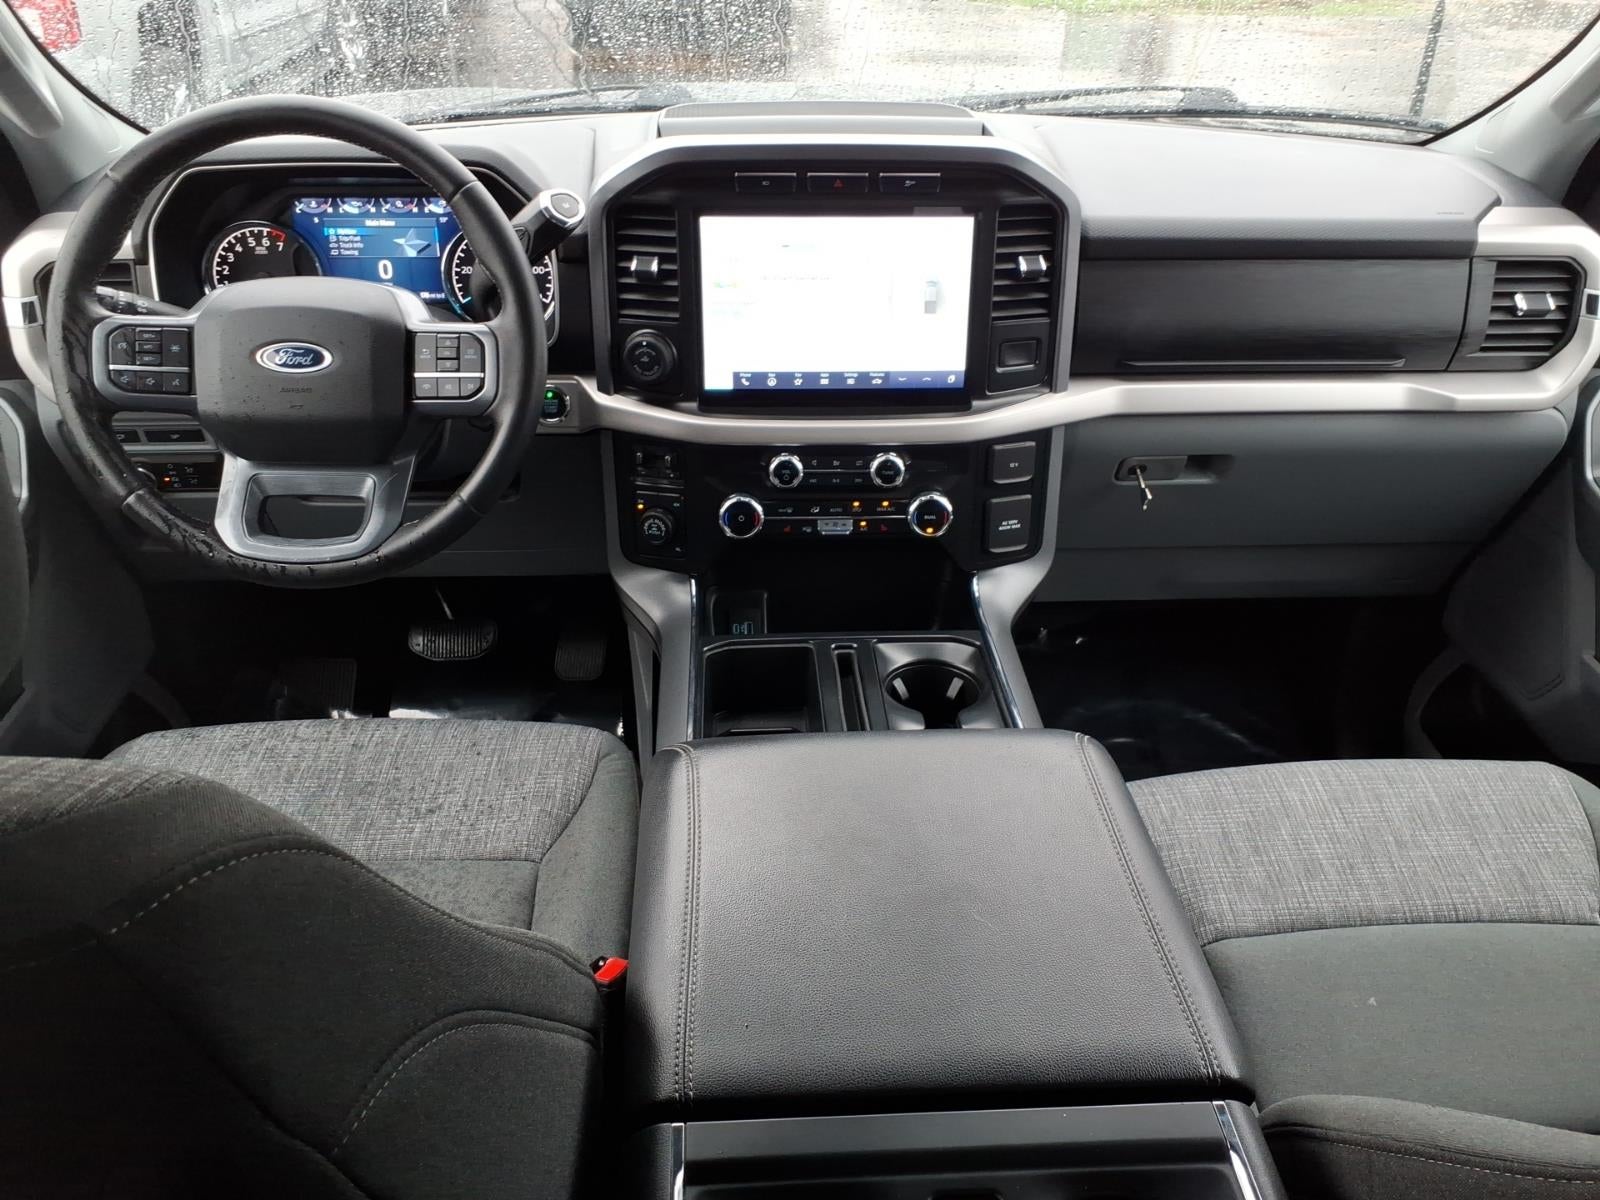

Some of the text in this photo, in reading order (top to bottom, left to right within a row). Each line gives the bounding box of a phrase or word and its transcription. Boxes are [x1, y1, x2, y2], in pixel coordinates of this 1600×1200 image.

[247, 237, 256, 247] 5
[262, 237, 270, 247] 6
[276, 242, 284, 252] 7
[234, 243, 243, 253] 4
[226, 252, 235, 262] 3
[222, 265, 230, 275] 2
[378, 259, 393, 280] 0
[461, 266, 473, 274] 20
[532, 266, 545, 274] 00
[275, 348, 314, 365] Ford
